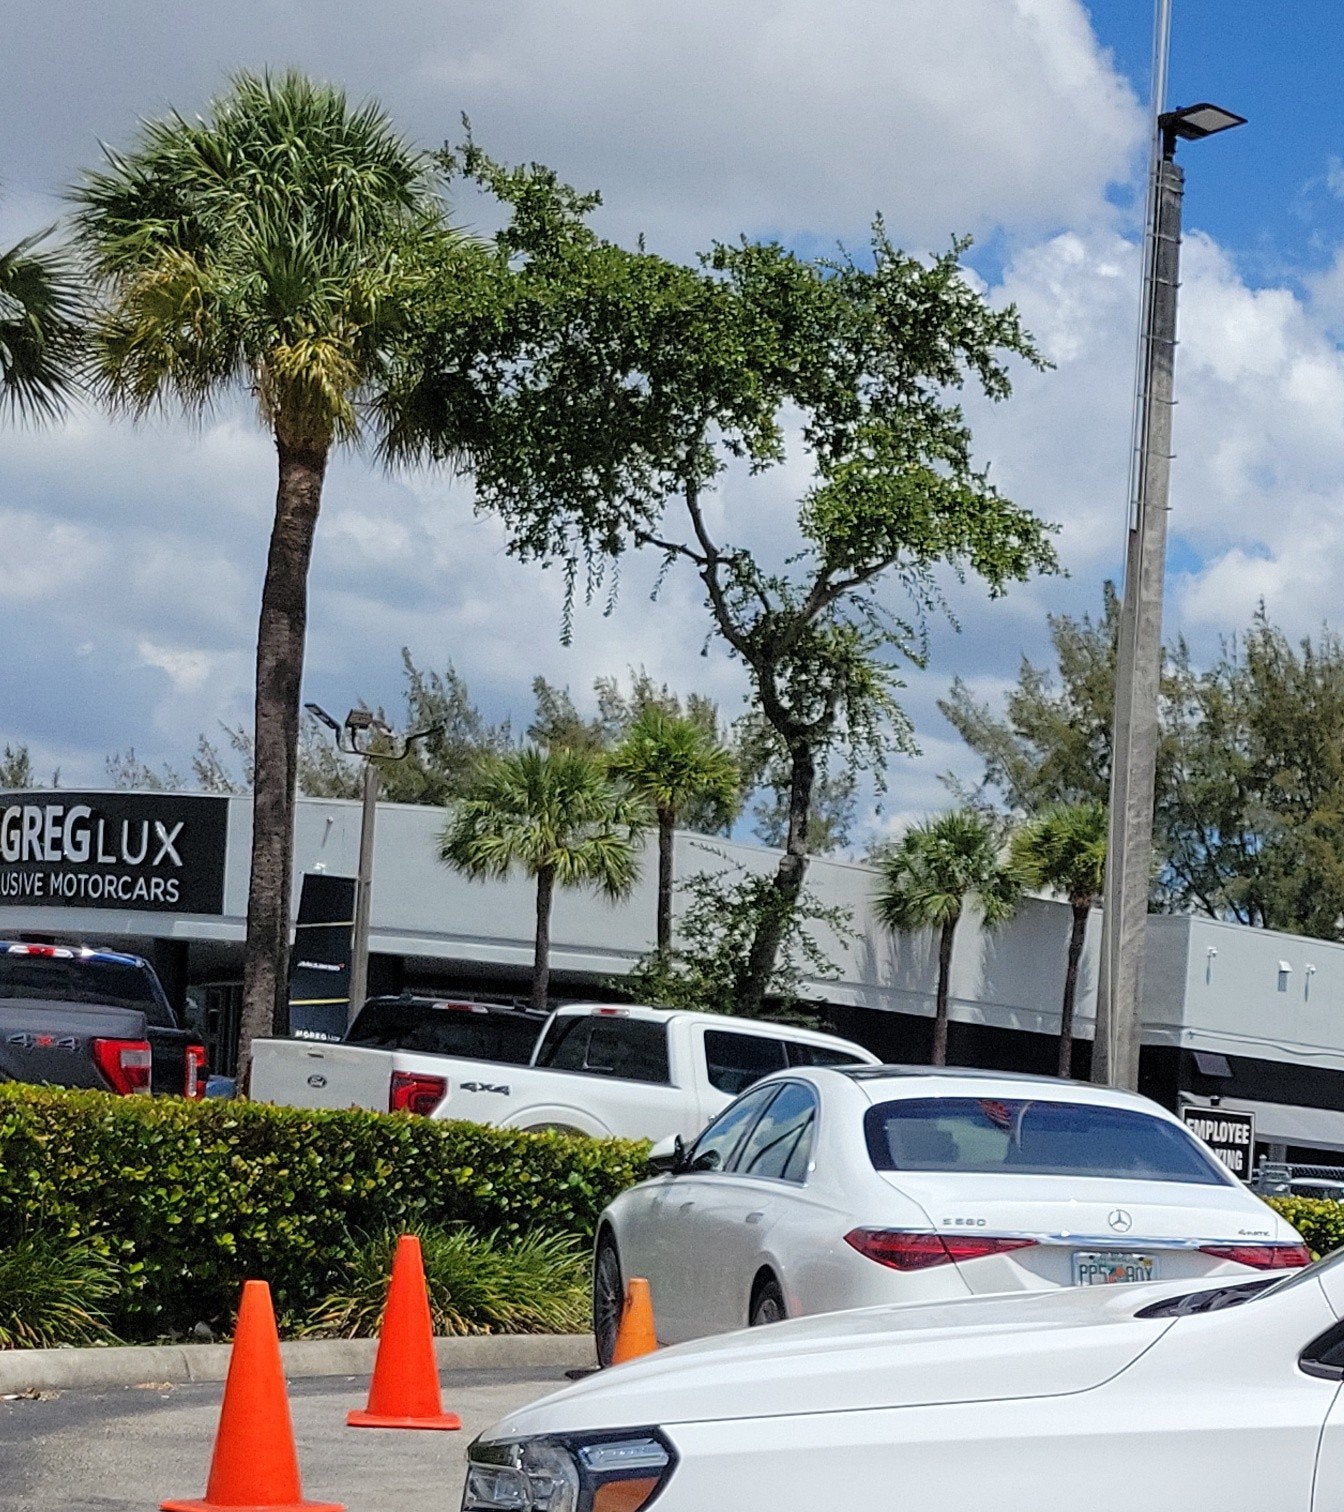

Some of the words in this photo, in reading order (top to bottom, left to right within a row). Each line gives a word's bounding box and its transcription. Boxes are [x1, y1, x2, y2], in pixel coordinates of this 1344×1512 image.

[0, 871, 44, 897] USIVE
[50, 872, 180, 903] MOTORCARS
[1186, 1117, 1250, 1145] EMPLOYEE
